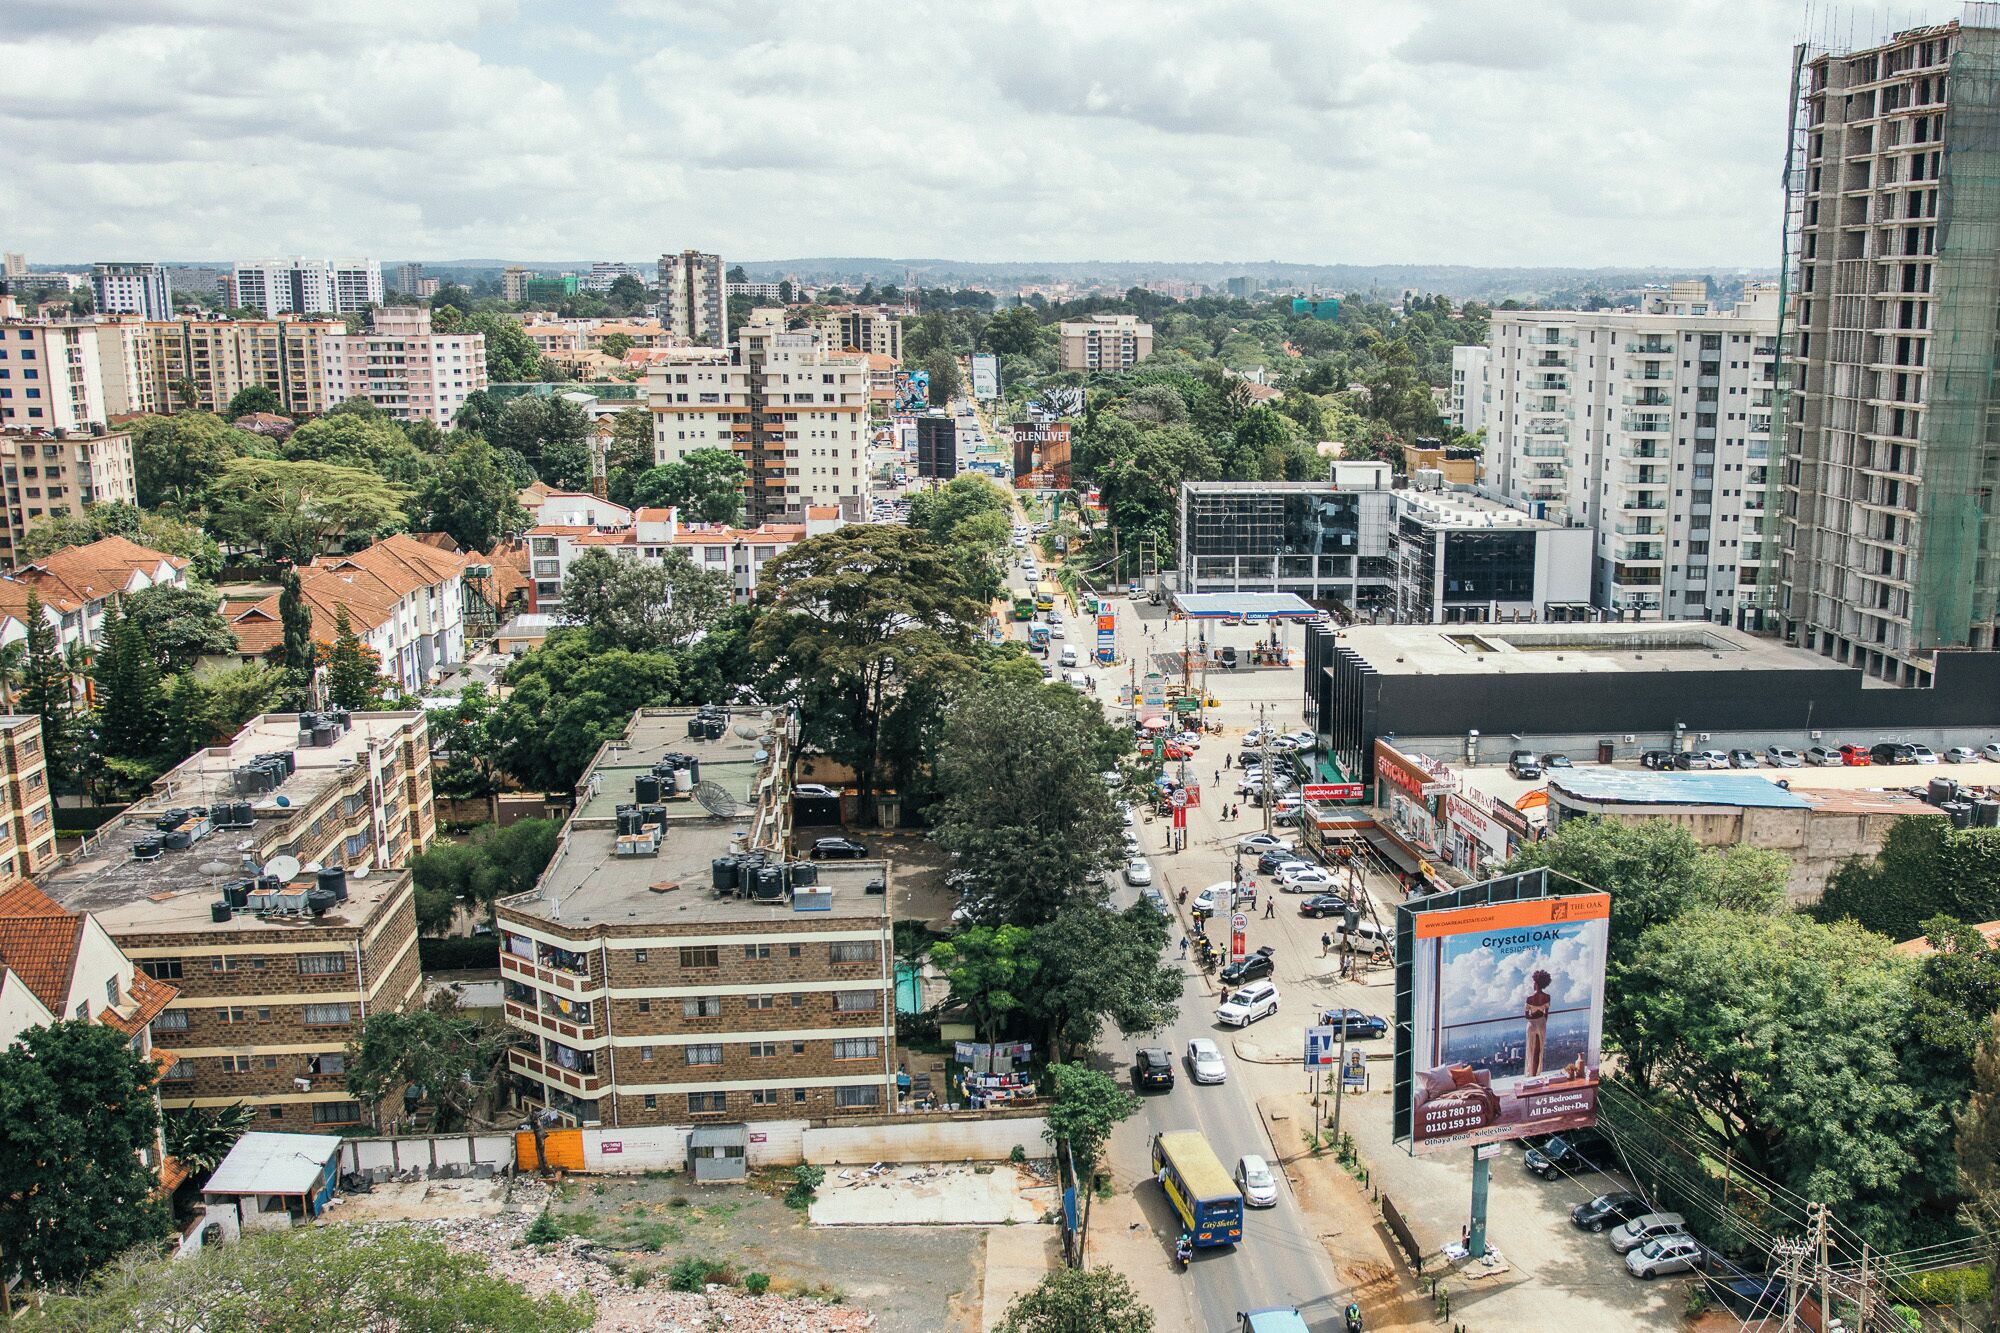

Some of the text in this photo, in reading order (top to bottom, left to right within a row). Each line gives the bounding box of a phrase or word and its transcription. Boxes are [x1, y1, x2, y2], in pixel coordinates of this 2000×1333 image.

[1034, 423, 1051, 431] THE
[1014, 431, 1071, 443] GLENLIVET
[1455, 798, 1487, 832] Healthcare
[1482, 929, 1560, 948] Crystal OAK
[1500, 944, 1541, 954] RESIDENCY
[1549, 1093, 1582, 1103] Bedrooms
[1426, 1104, 1481, 1121] 0718 780 780
[1542, 1101, 1589, 1115] En-Suite+Dsq
[1425, 1116, 1481, 1133] 0110 159 159
[1424, 1137, 1451, 1146] Othaya
[1474, 1125, 1512, 1137] Kileleshwa
[1202, 1221, 1217, 1230] City
